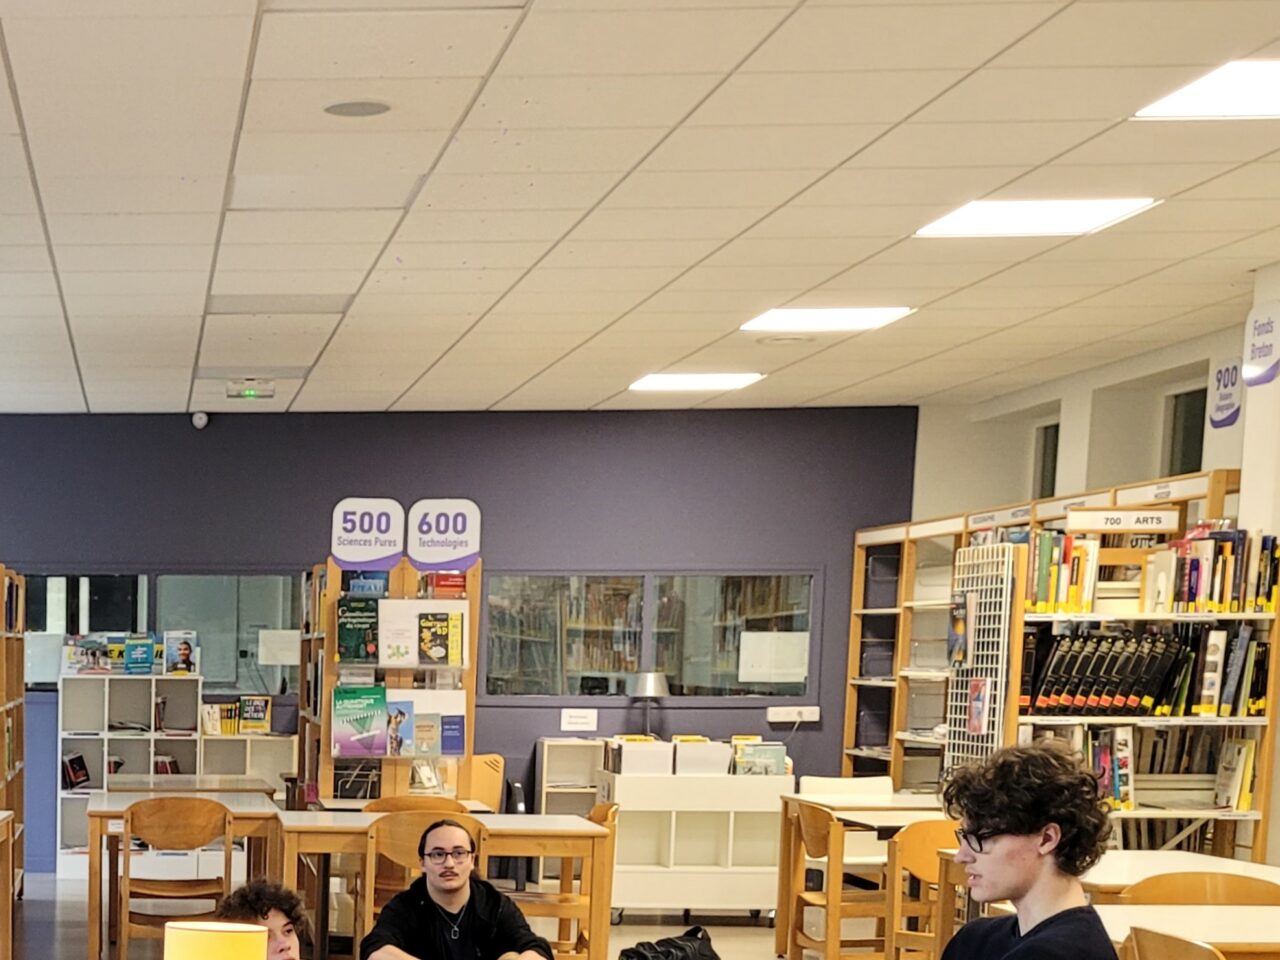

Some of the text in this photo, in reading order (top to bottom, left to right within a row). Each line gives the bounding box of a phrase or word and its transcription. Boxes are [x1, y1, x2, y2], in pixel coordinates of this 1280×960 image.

[1216, 365, 1238, 391] 900
[341, 511, 391, 534] 500
[417, 512, 467, 535] 600
[1104, 516, 1162, 526] 700 ARTS
[337, 536, 397, 548] Sciences Pures
[418, 537, 469, 550] Technologies
